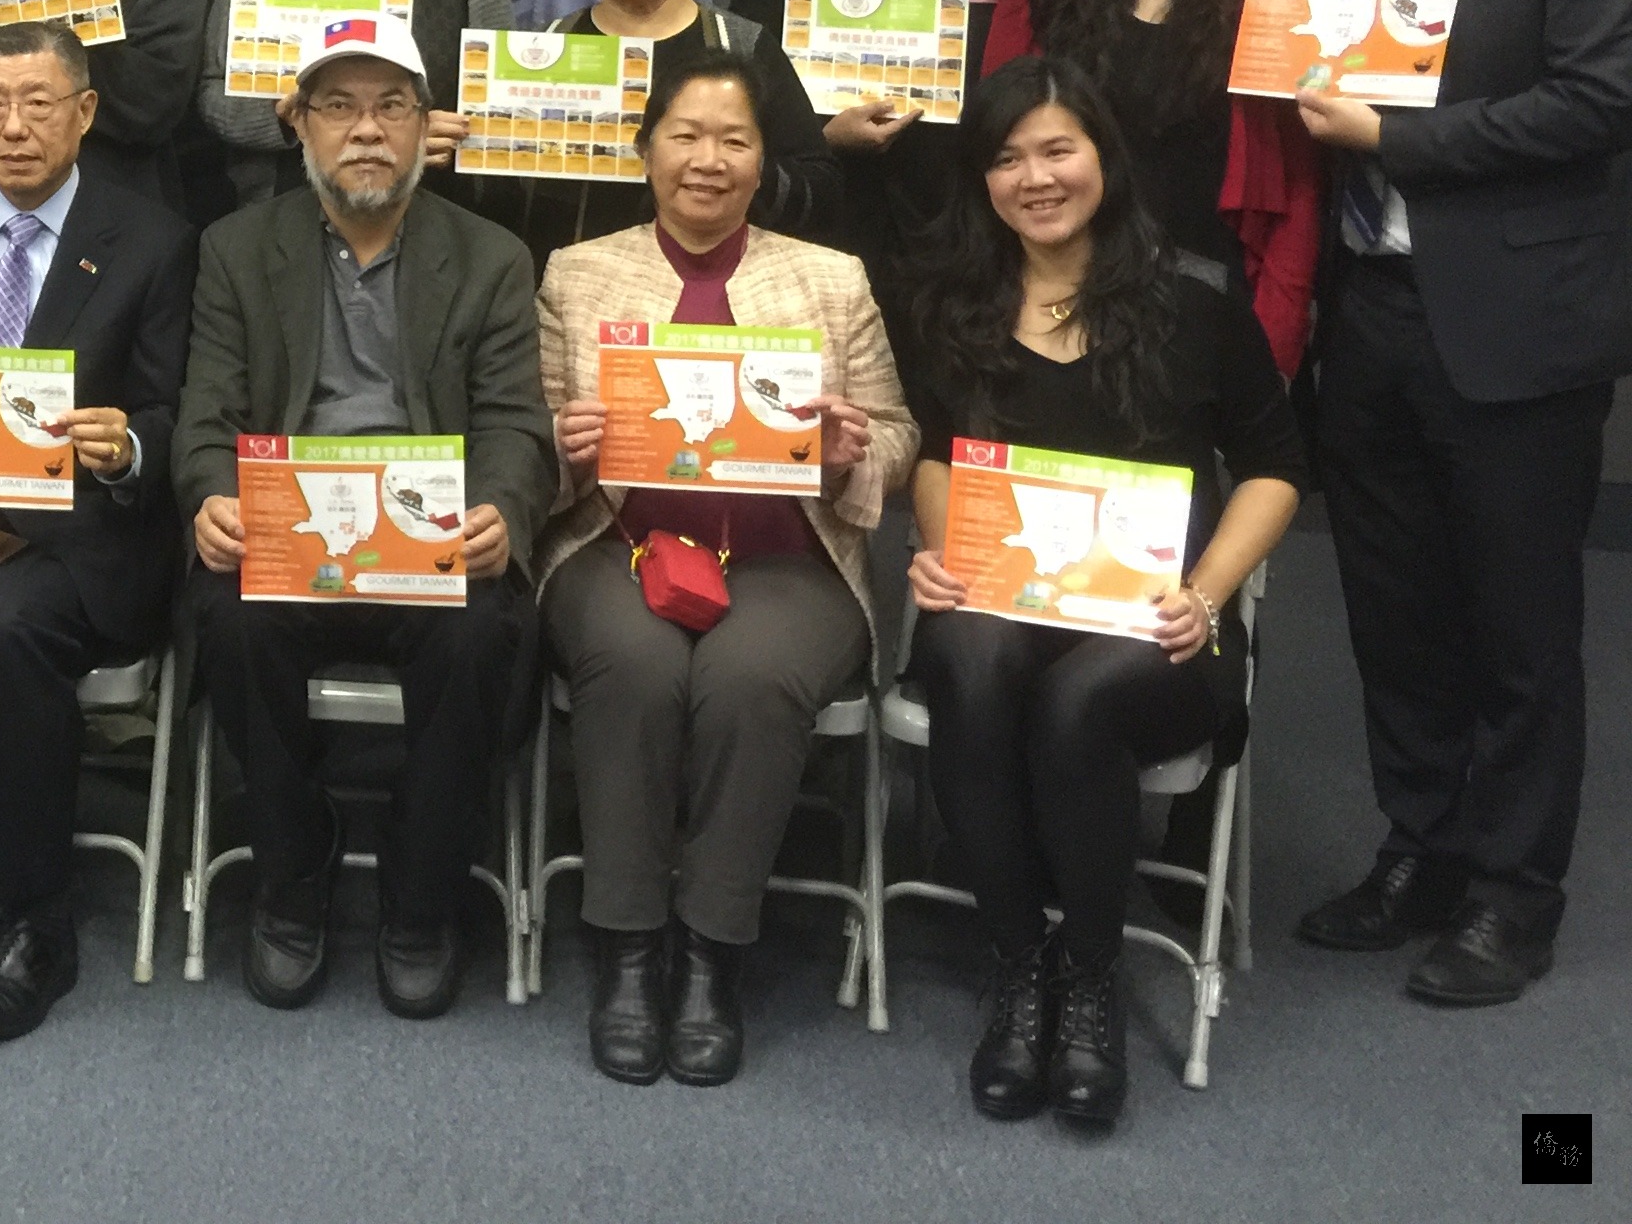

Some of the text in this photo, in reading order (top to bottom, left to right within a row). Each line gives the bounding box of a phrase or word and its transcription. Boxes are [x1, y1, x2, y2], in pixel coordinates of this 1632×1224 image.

[722, 462, 770, 475] GOURMET
[366, 575, 457, 587] GOURMET TAIWAN
